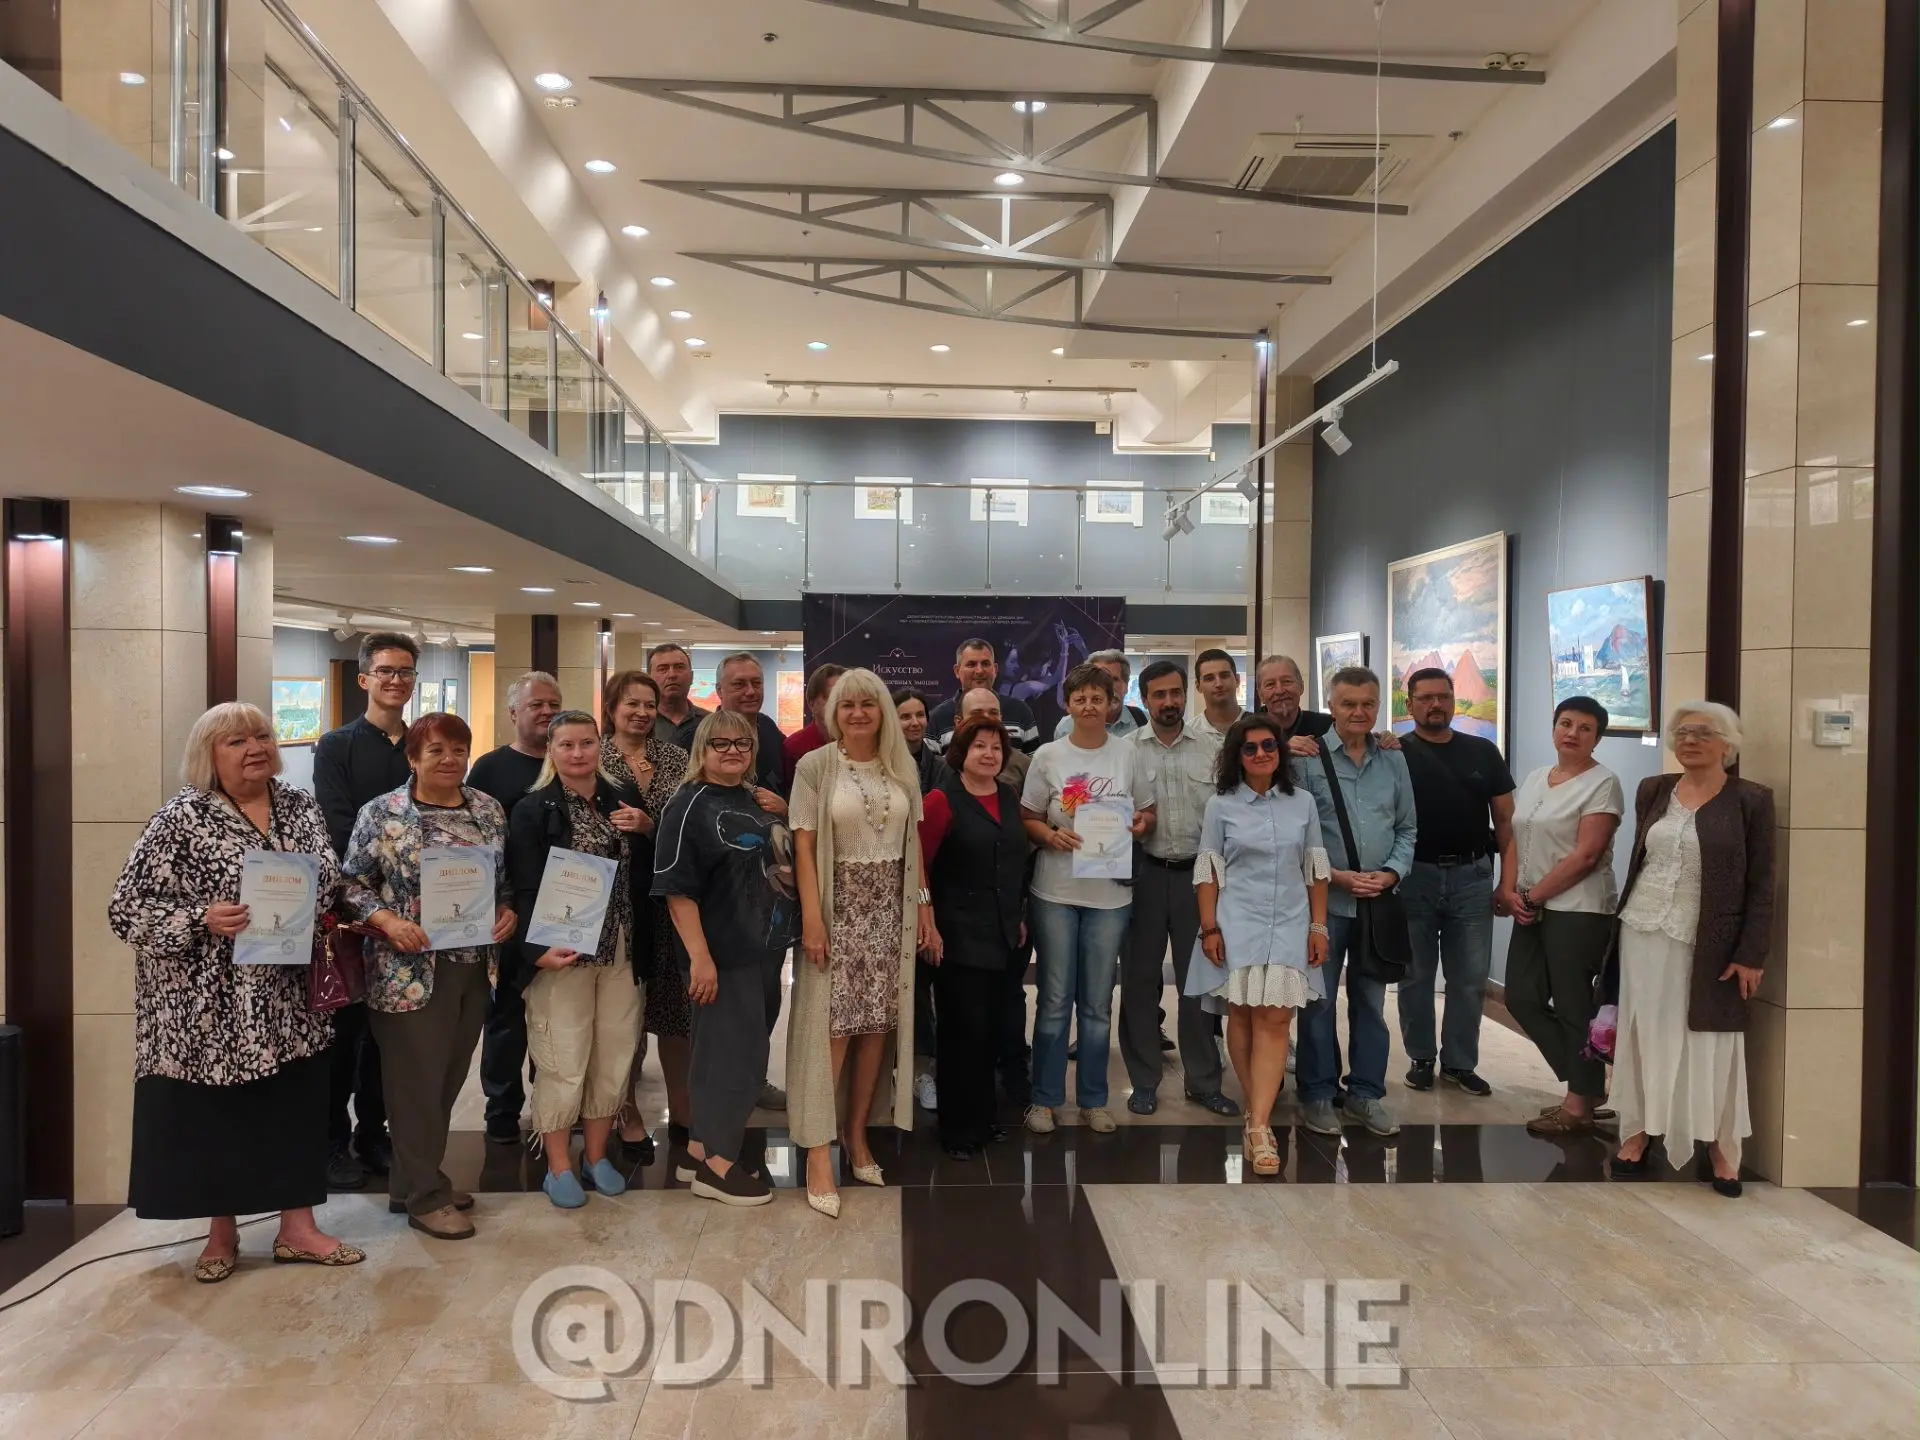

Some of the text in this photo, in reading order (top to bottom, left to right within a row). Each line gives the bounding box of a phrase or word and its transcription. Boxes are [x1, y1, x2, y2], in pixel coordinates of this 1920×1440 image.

[873, 663, 923, 676] Искусство
[439, 867, 478, 877] ДИПЛОМ
[560, 870, 597, 885] ДИПЛОМ
[263, 874, 302, 885] ДИПЛОМ
